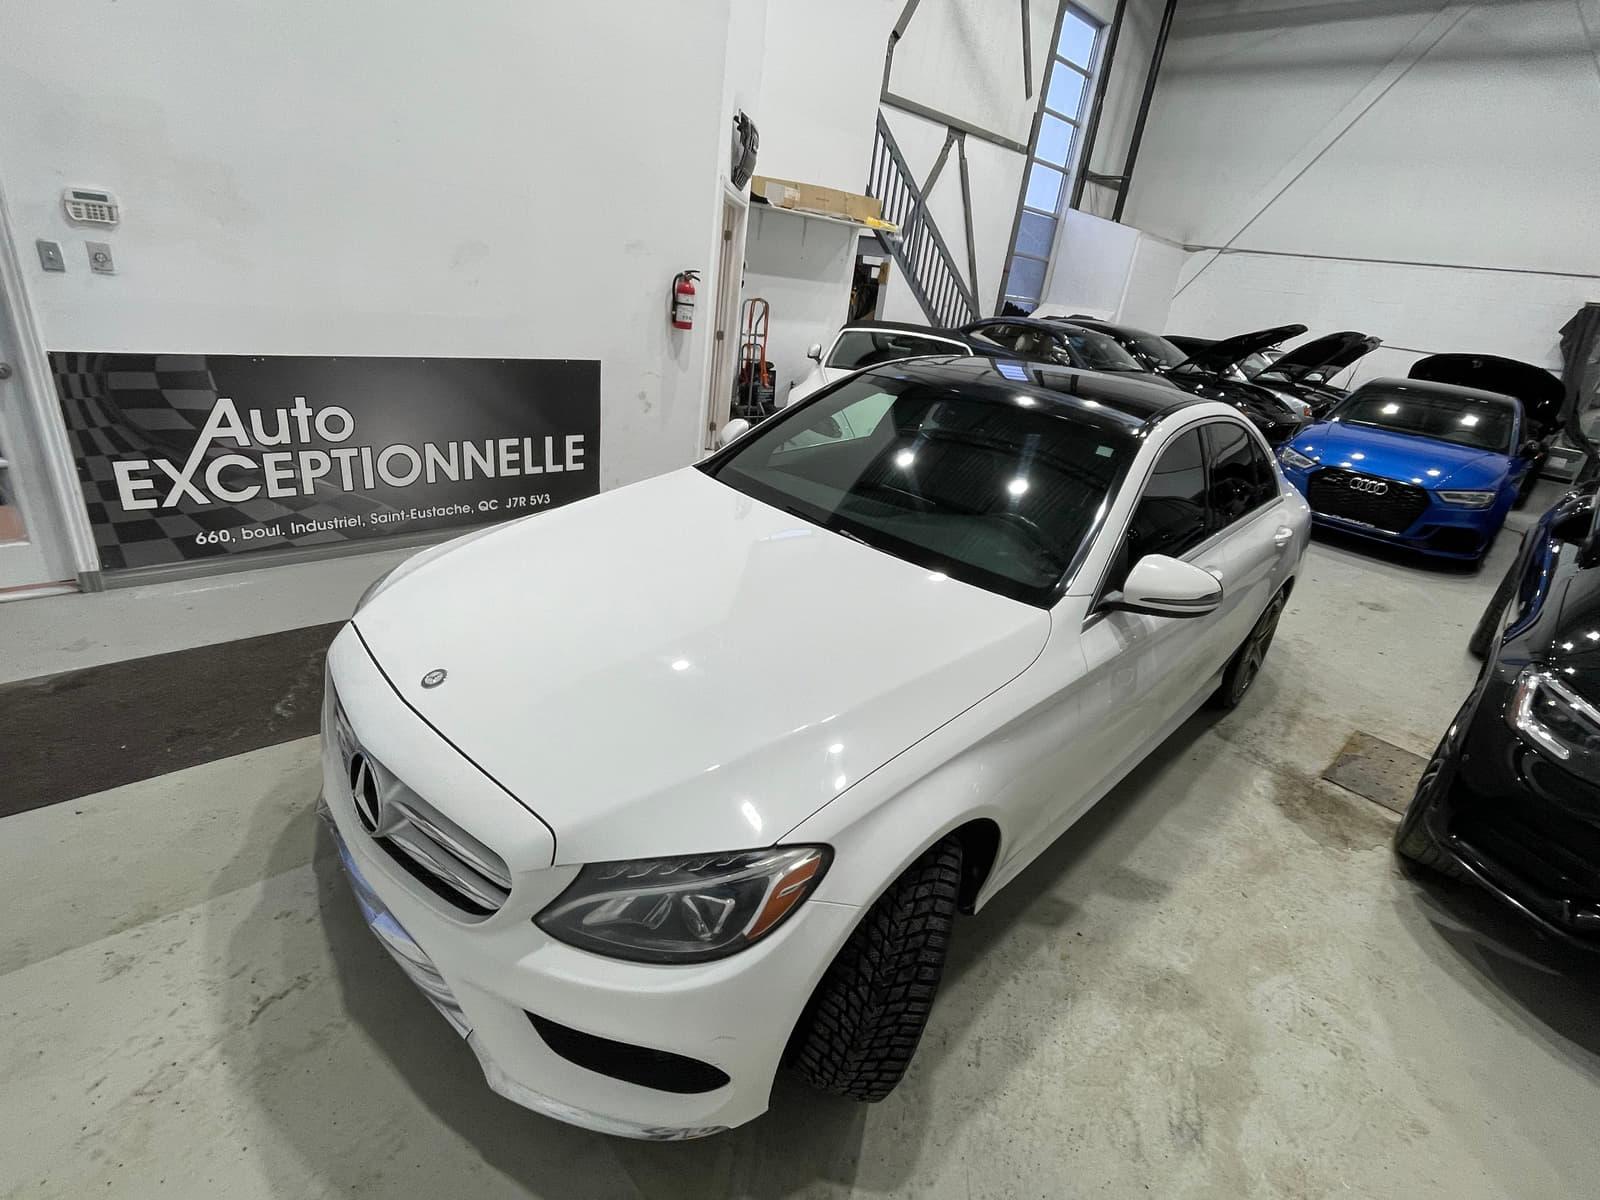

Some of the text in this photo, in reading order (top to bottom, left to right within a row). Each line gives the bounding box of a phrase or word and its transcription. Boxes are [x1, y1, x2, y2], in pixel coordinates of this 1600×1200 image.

[197, 396, 355, 447] Auto
[112, 433, 586, 511] EXCEPTIONNELLE
[195, 493, 551, 545] 660, boul. Industriel, Saint-Eustache, QC J7R 5V3
